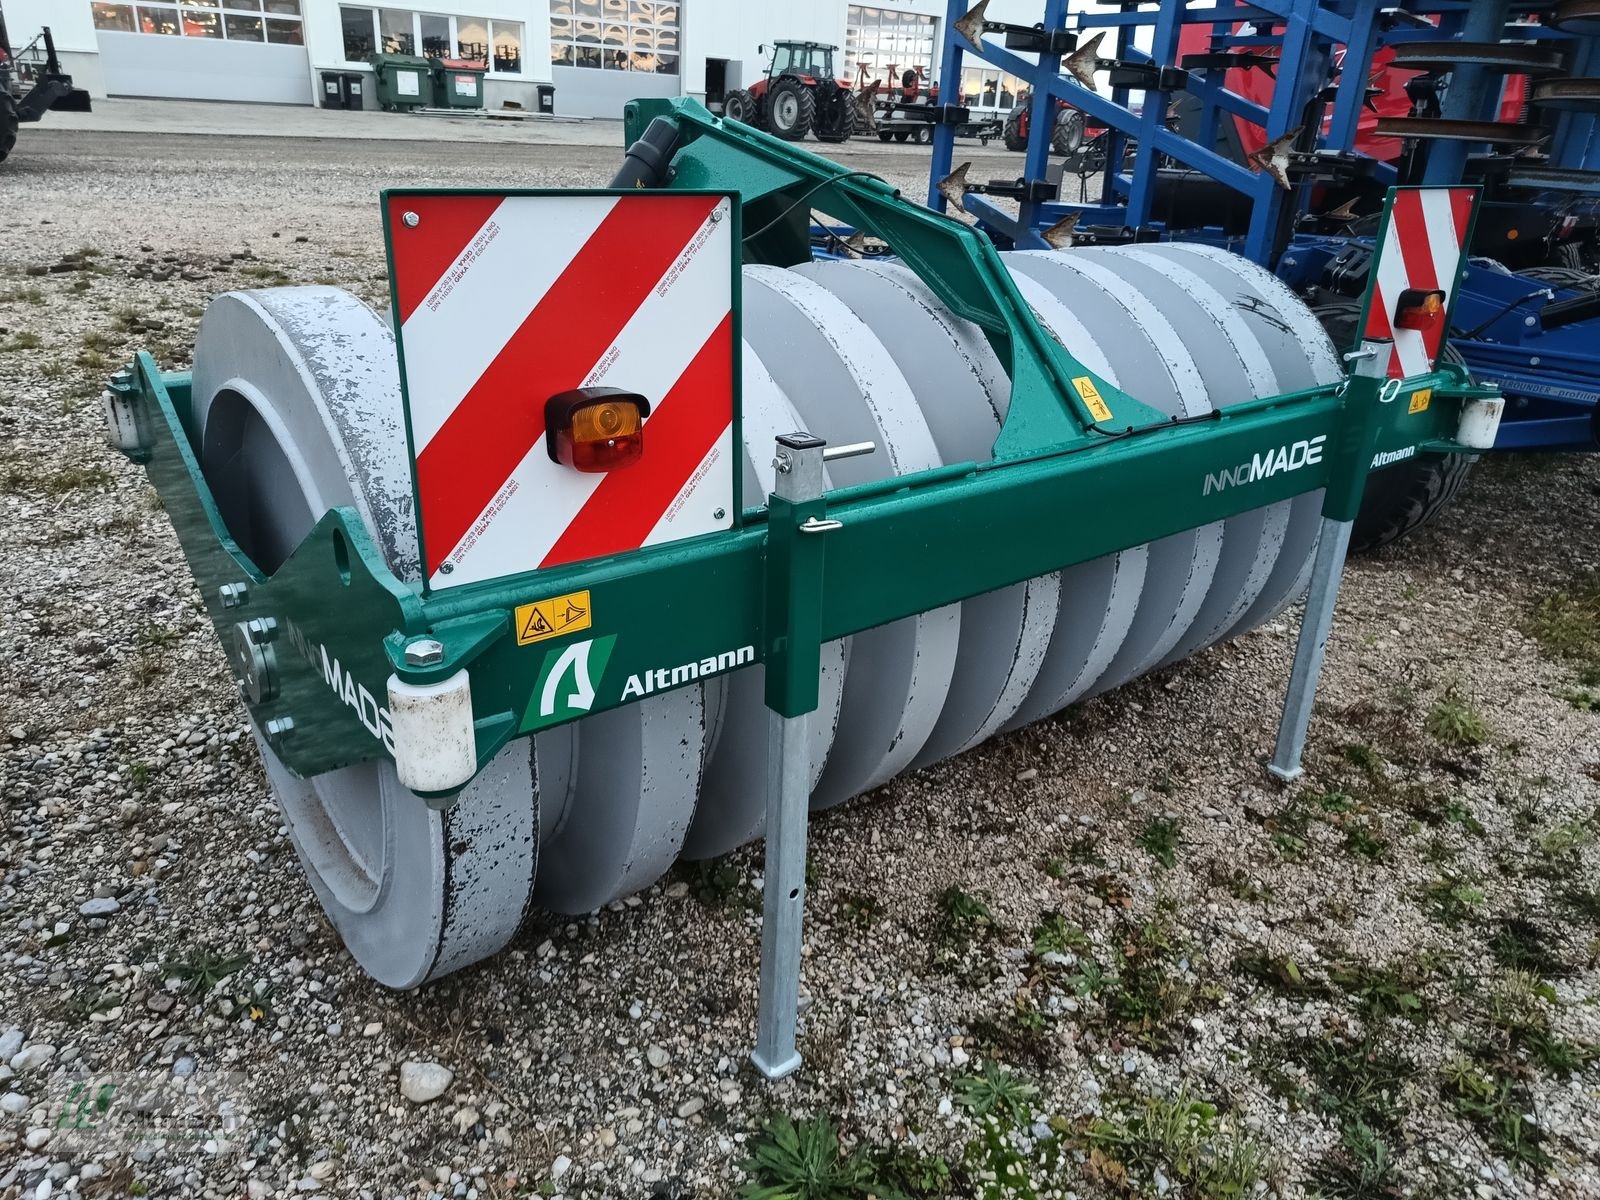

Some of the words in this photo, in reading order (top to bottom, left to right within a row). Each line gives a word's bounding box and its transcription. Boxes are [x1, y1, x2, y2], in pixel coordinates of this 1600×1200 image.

[458, 250, 472, 267] GEKA
[431, 301, 441, 312] DIN
[440, 285, 453, 301] 11030
[454, 266, 469, 283] GEKA
[470, 255, 477, 263] TP
[475, 240, 490, 256] ESC-A
[1370, 445, 1415, 469] Altmann
[477, 520, 490, 536] GEKA
[620, 644, 755, 702] Altmann
